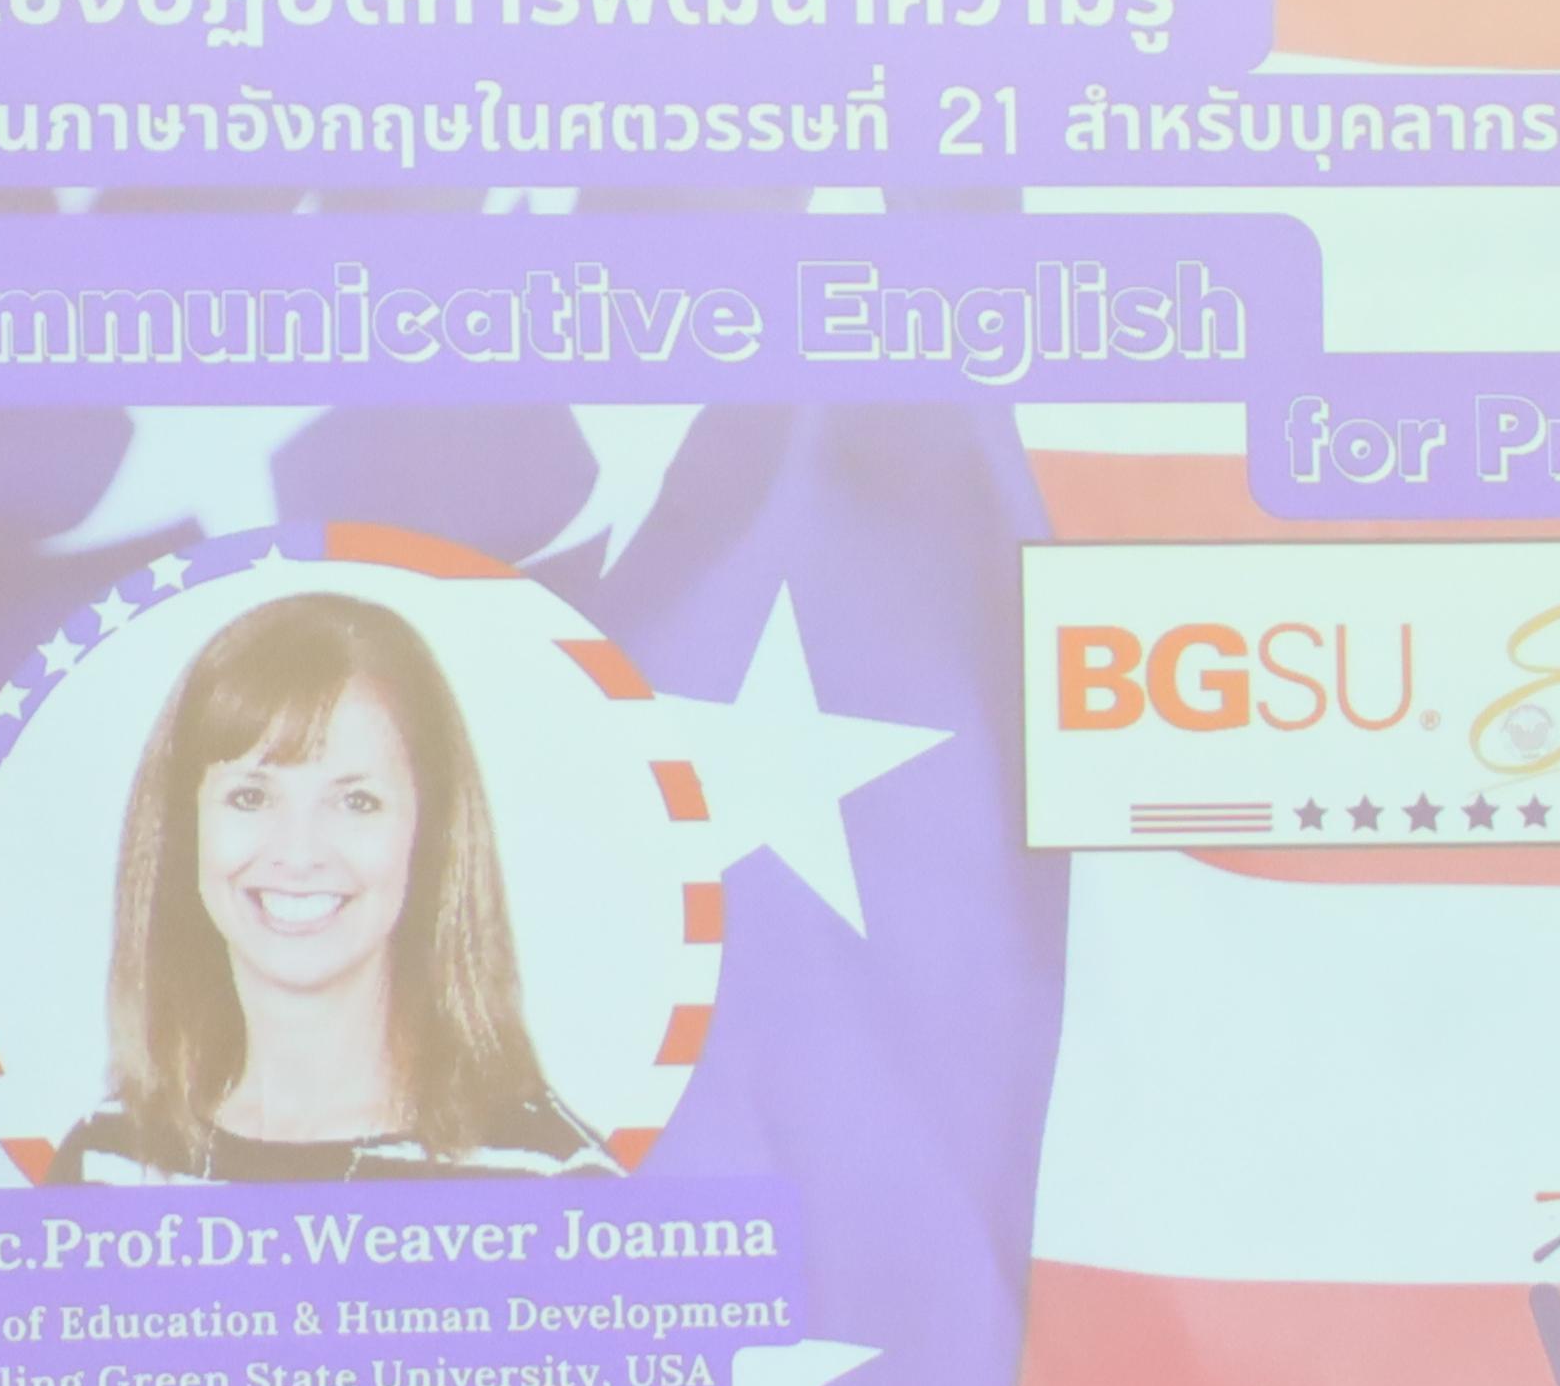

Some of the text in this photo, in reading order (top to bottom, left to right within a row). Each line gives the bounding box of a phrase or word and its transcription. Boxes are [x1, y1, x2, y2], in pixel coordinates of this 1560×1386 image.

[940, 87, 1016, 154] 21
[798, 261, 1246, 385] English
[1285, 396, 1446, 484] for
[556, 1210, 776, 1260] Joanna
[3, 1306, 46, 1341] of
[60, 1301, 278, 1340] Education
[293, 1301, 322, 1335] &
[338, 1302, 491, 1333] Human
[508, 1295, 790, 1339] Development
